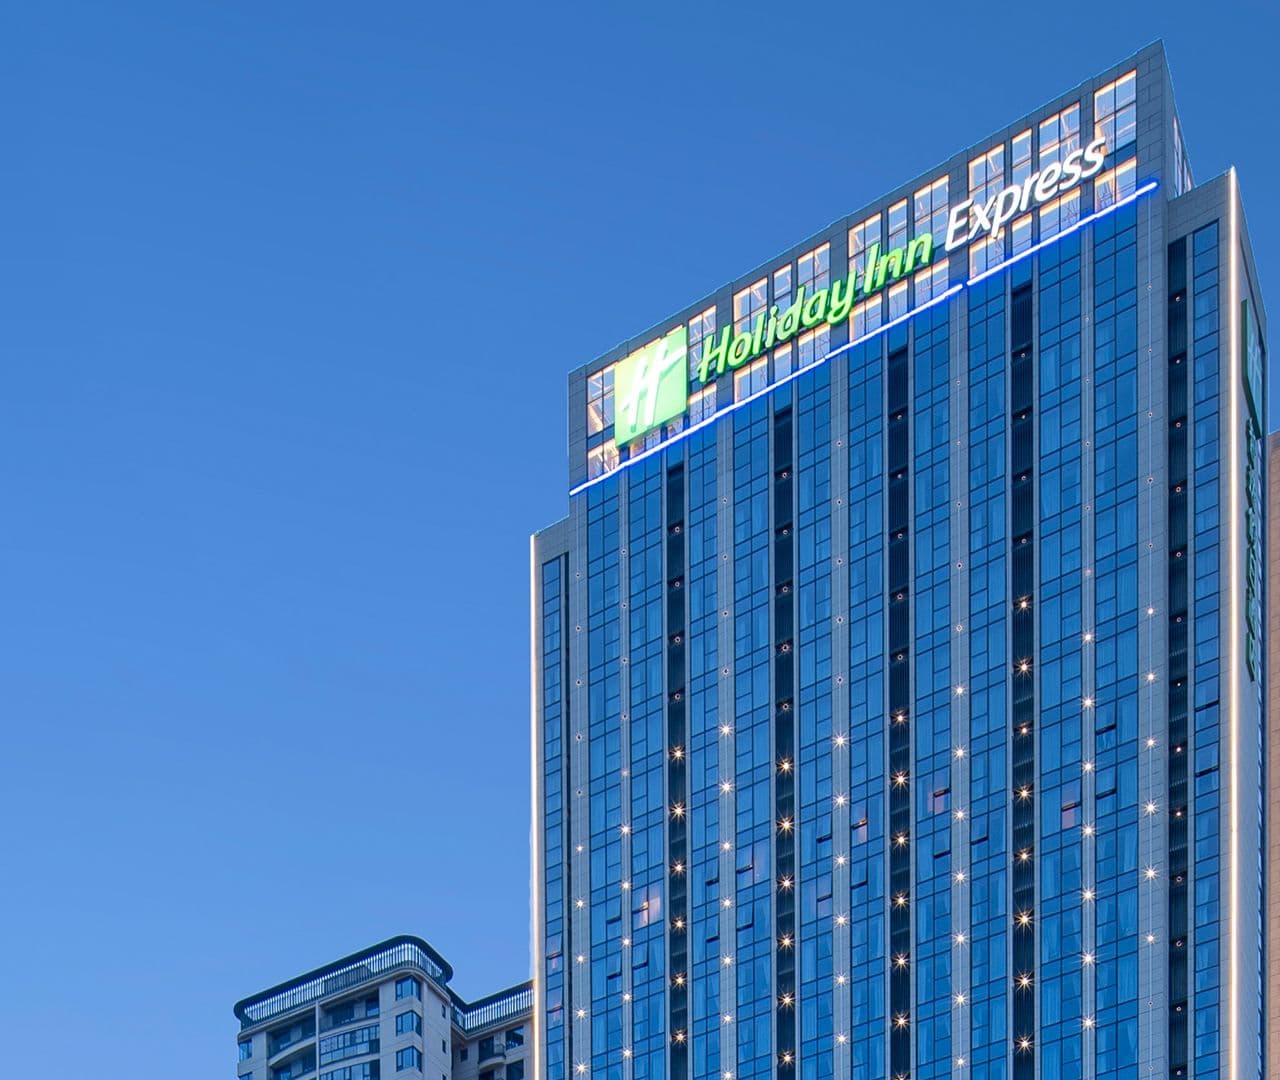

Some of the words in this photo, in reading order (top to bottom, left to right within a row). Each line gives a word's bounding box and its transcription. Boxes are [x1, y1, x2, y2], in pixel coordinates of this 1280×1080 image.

[697, 271, 857, 383] Holiday
[863, 232, 934, 294] Inn
[945, 137, 1106, 251] Express
